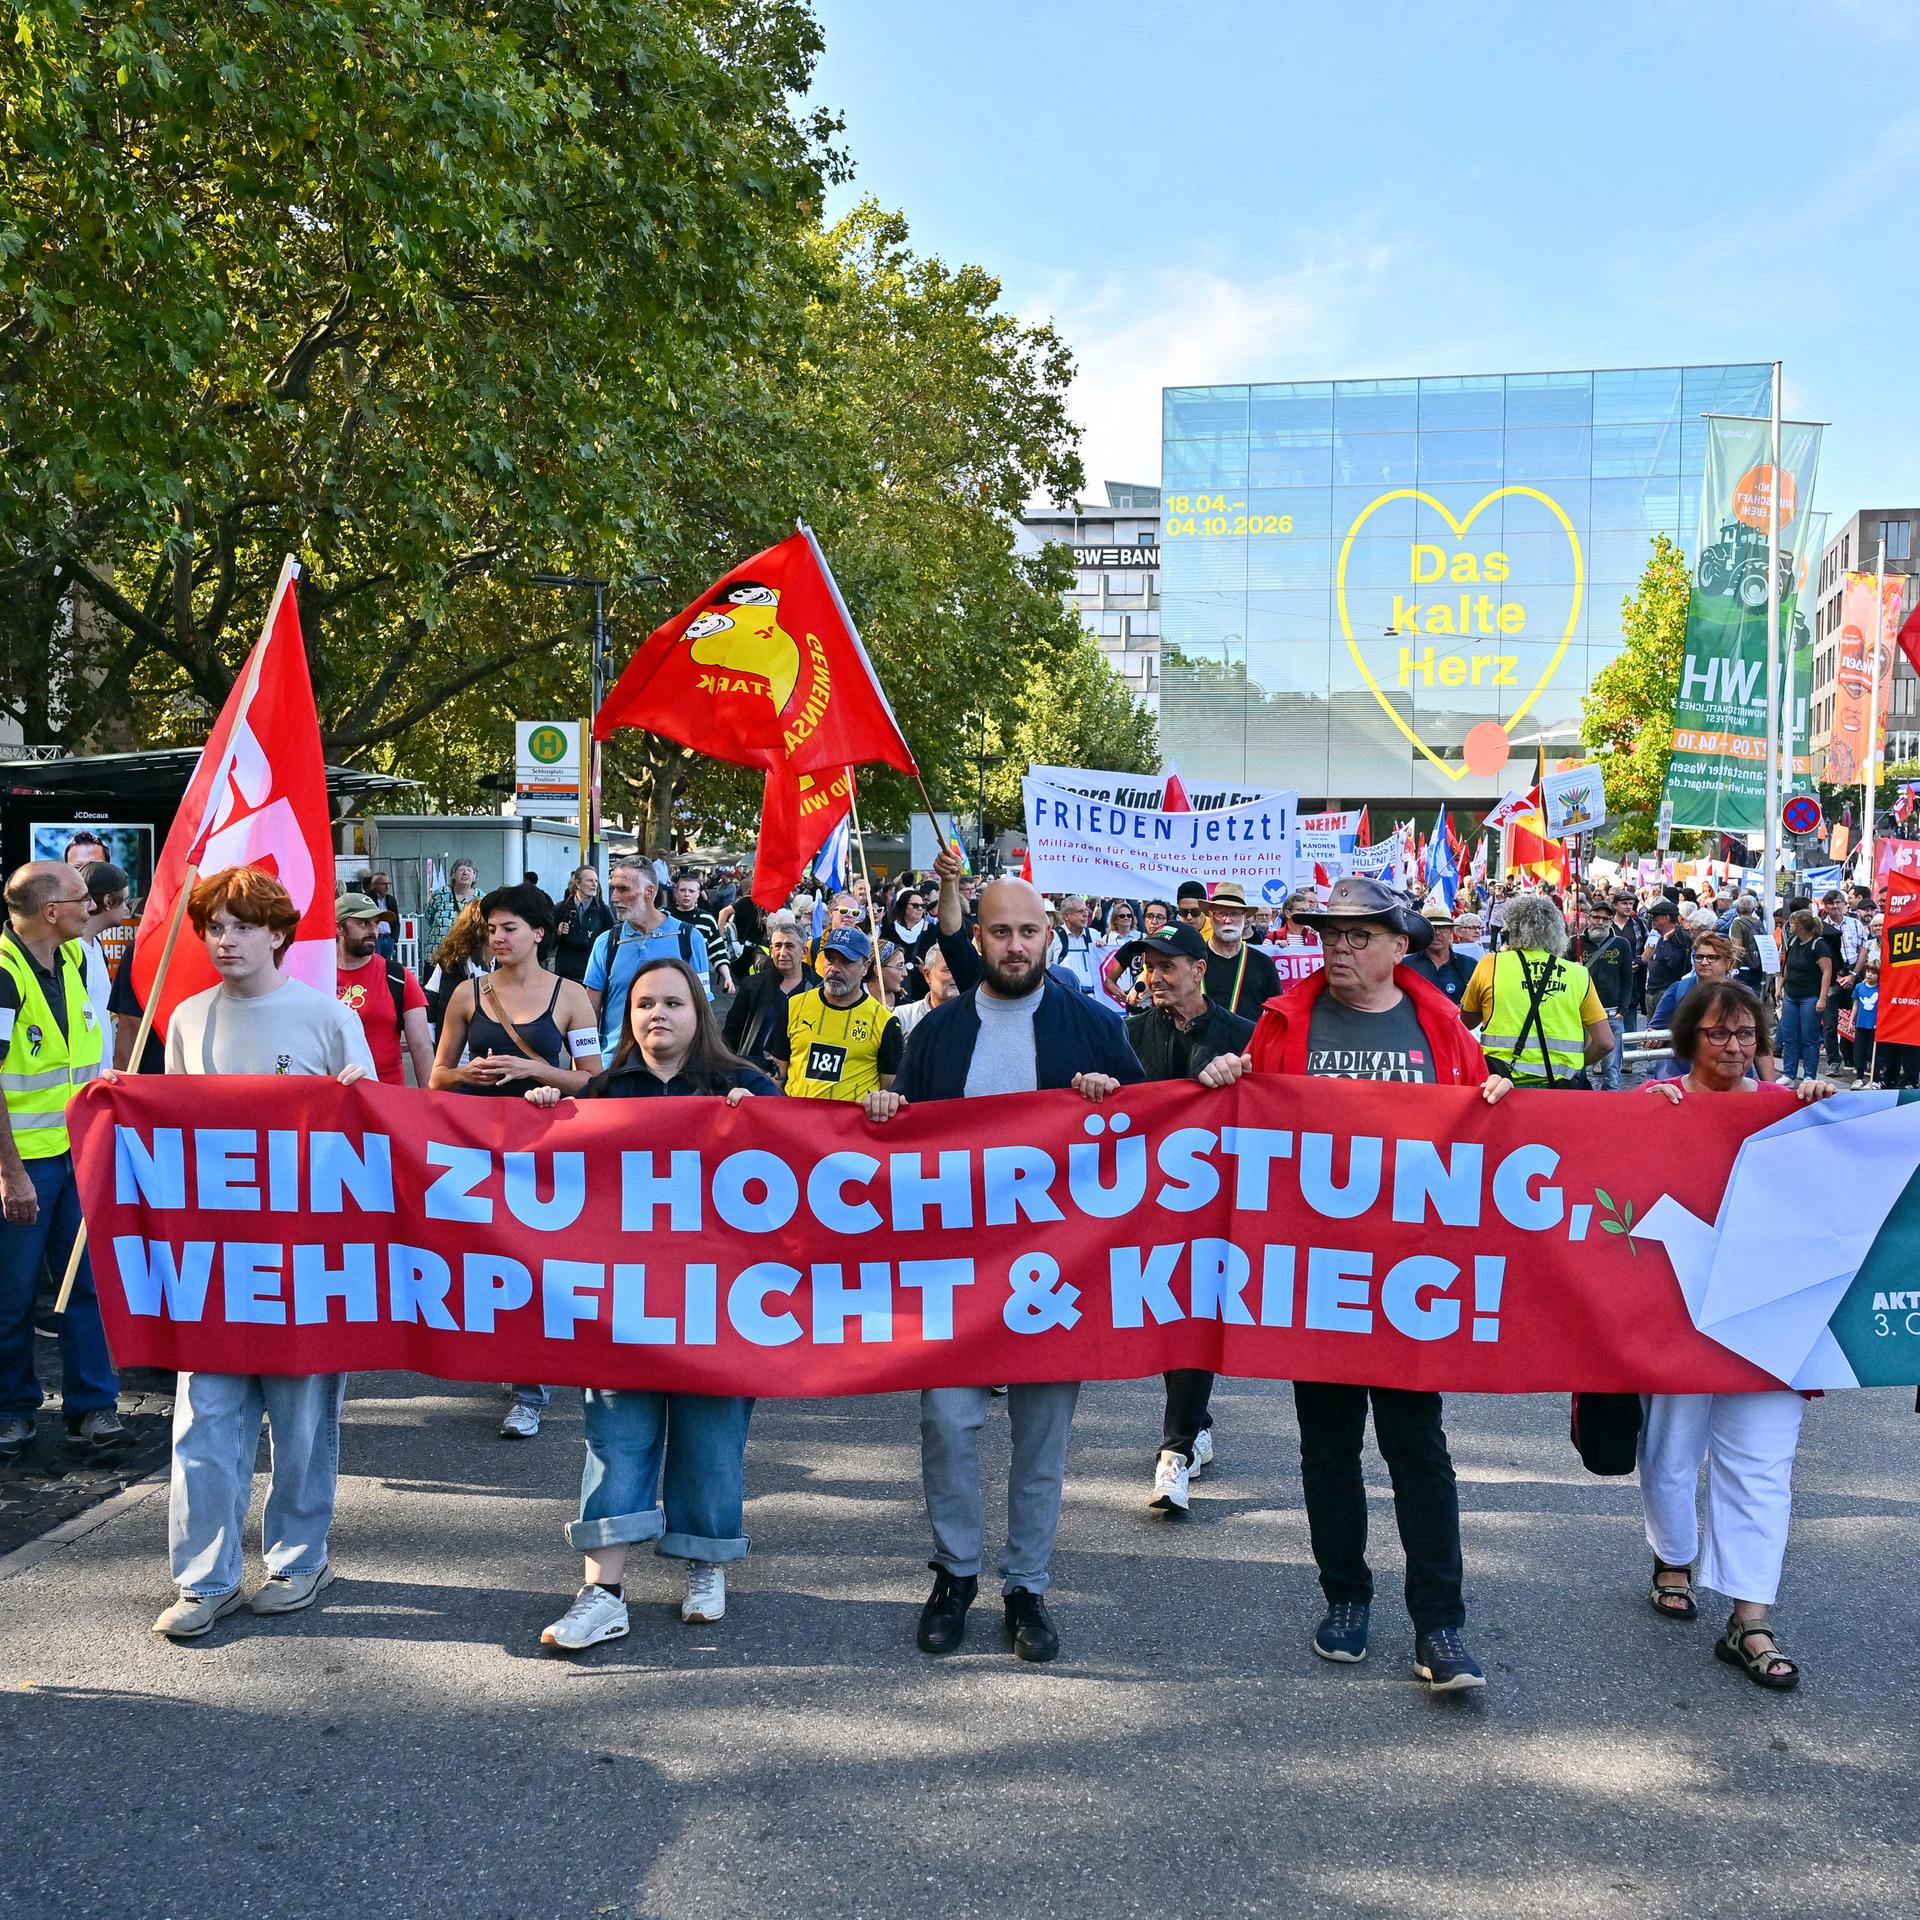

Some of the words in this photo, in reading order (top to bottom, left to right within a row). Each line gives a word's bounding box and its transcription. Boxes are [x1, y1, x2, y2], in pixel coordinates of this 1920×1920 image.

[1168, 515, 1293, 536] 04.10.2026
[1120, 549, 1160, 565] BAN
[1411, 544, 1509, 583] Das
[1393, 595, 1525, 635] kalte
[1399, 646, 1518, 686] Herz
[74, 811, 109, 819] JCDecaux
[1036, 797, 1172, 840] FRIEDEN
[1190, 808, 1286, 849] jetzt!
[1304, 815, 1347, 831] NEIN!
[1038, 838, 1102, 853] Milliarden
[1107, 845, 1125, 855] für
[1130, 849, 1148, 858] ein
[1153, 852, 1186, 862] gutes
[1192, 852, 1229, 861] Leben
[1234, 852, 1252, 861] für
[1257, 852, 1281, 861] Alle
[1038, 854, 1066, 862] statt
[1072, 854, 1089, 864] für
[1094, 857, 1134, 871] KRIEG,
[1139, 861, 1198, 875] RÜSTUNG
[1204, 867, 1226, 876] und
[1232, 867, 1281, 876] PROFIT!
[1890, 895, 1911, 906] DKP
[1893, 931, 1914, 956] EU
[575, 1037, 597, 1047] ORDNER
[852, 1026, 867, 1039] BVB
[812, 1051, 841, 1073] 1&1
[1309, 1051, 1406, 1071] RADIKAL
[115, 1125, 396, 1213] NEIN
[425, 1141, 585, 1231] ZU
[622, 1113, 1594, 1240] HOCHRÜSTUNG,
[113, 1236, 974, 1347] WEHRPFLICHT
[1003, 1252, 1083, 1334] &
[1110, 1238, 1507, 1343] KRIEG!
[1874, 1313, 1897, 1336] 3.
